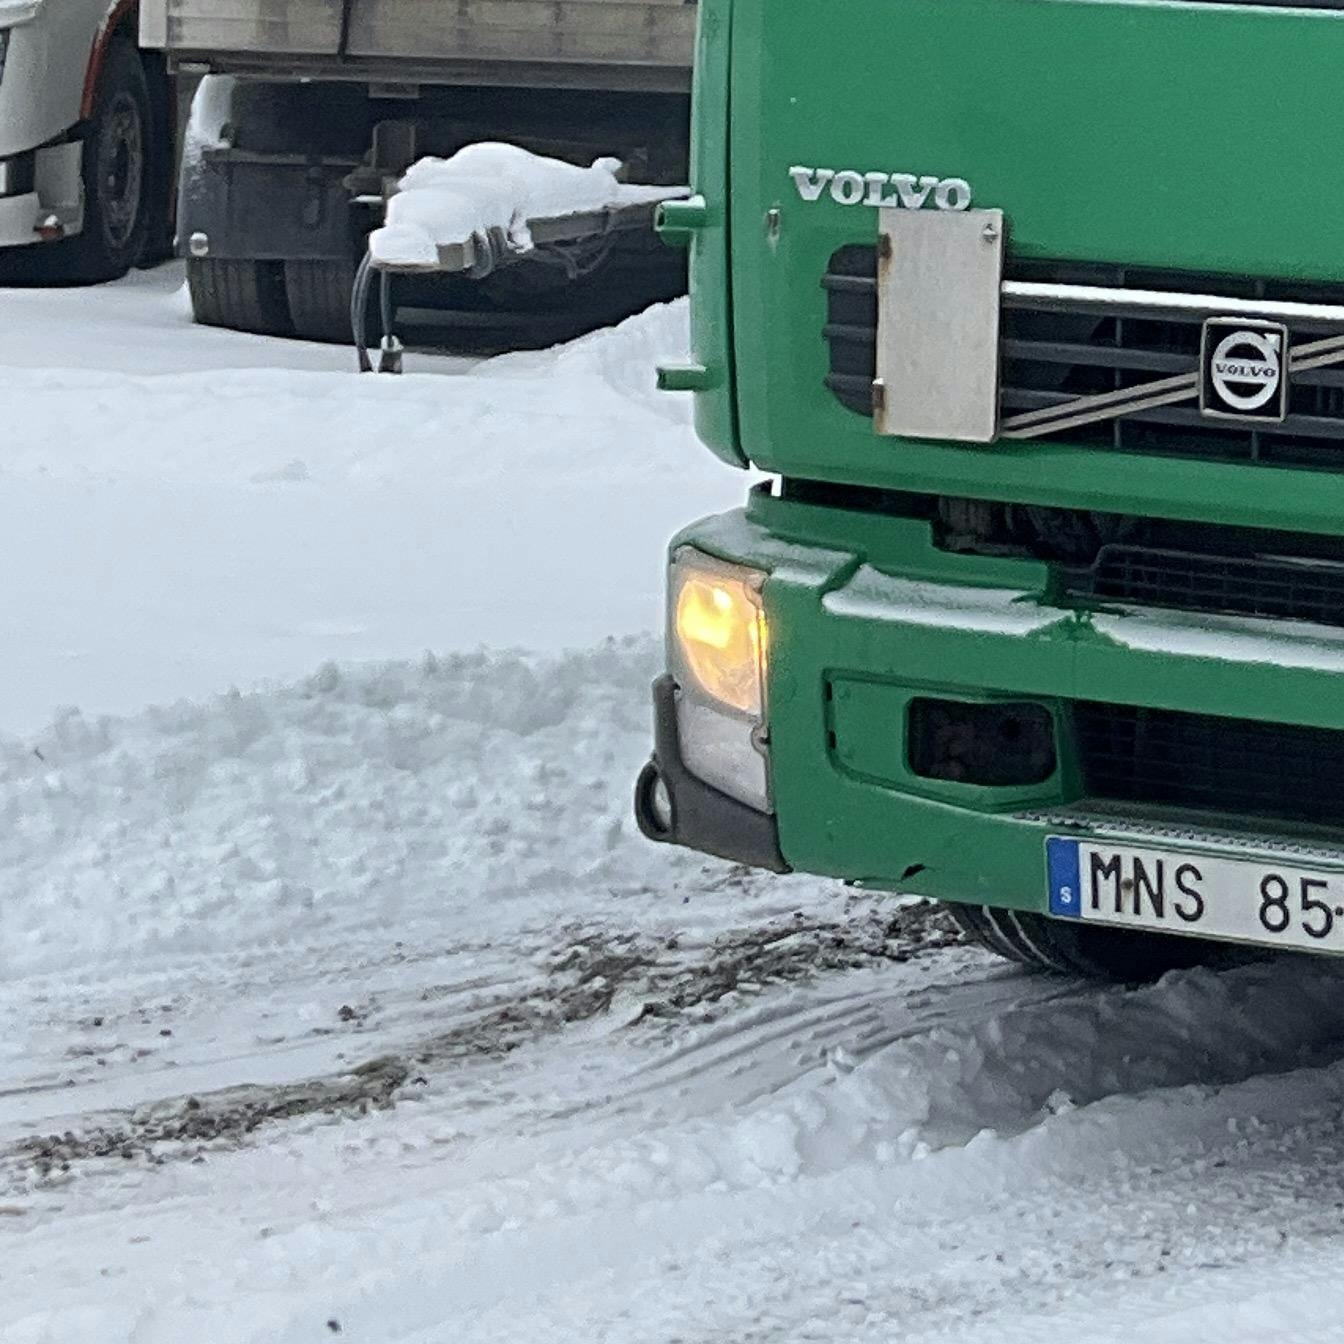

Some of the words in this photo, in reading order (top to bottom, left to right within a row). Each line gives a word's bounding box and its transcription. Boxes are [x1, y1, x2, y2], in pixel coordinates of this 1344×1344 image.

[788, 165, 971, 211] VOLVO
[1215, 363, 1276, 377] VOLVO
[1060, 886, 1072, 904] S
[1090, 851, 1204, 922] MNS
